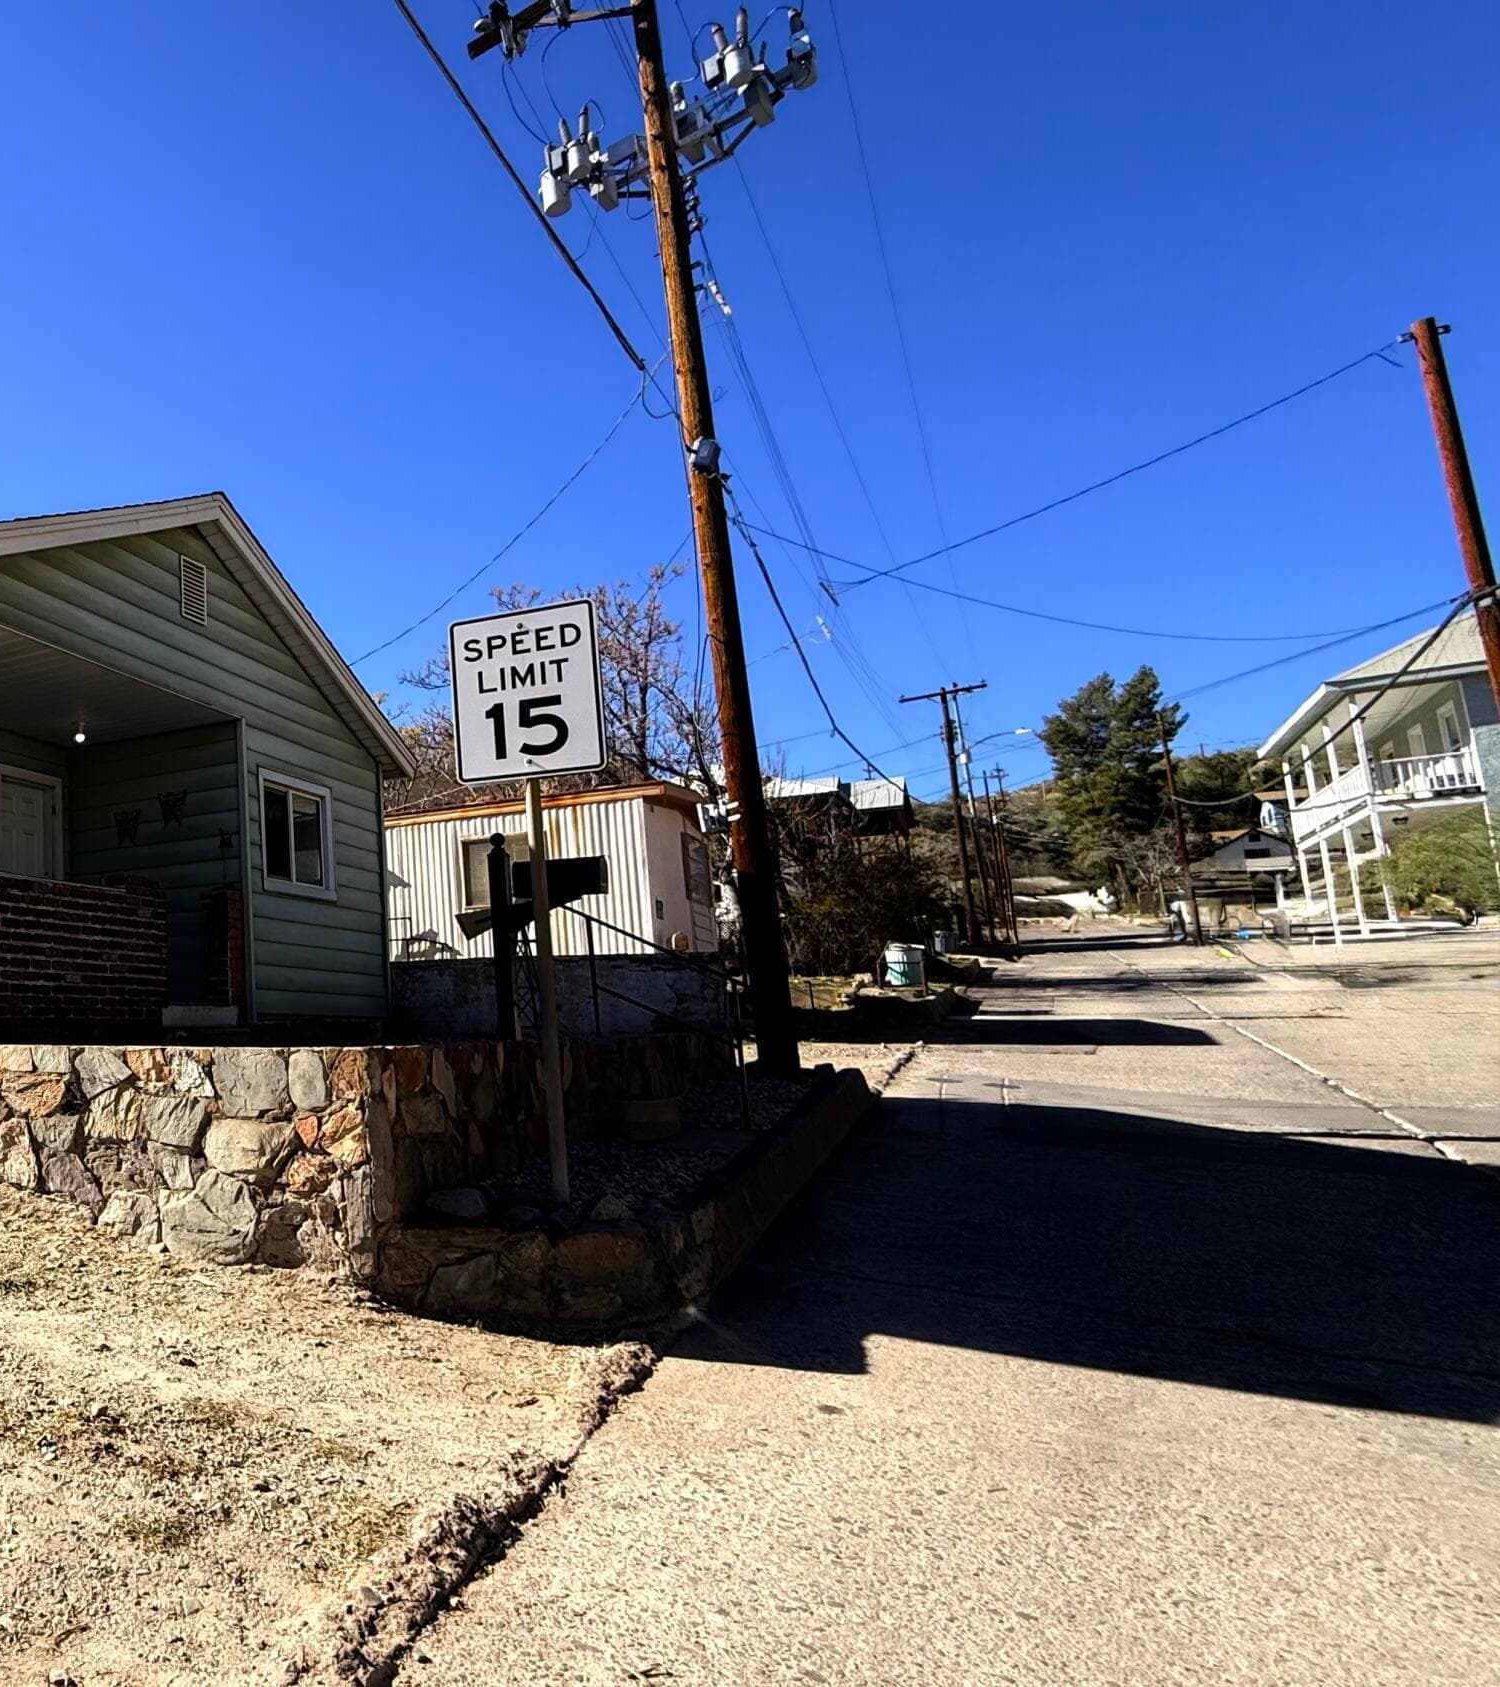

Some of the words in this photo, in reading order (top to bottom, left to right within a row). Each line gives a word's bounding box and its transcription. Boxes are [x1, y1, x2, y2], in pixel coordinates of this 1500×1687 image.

[463, 623, 582, 662] SPEED
[477, 657, 569, 695] LIMIT
[484, 694, 569, 760] 15
